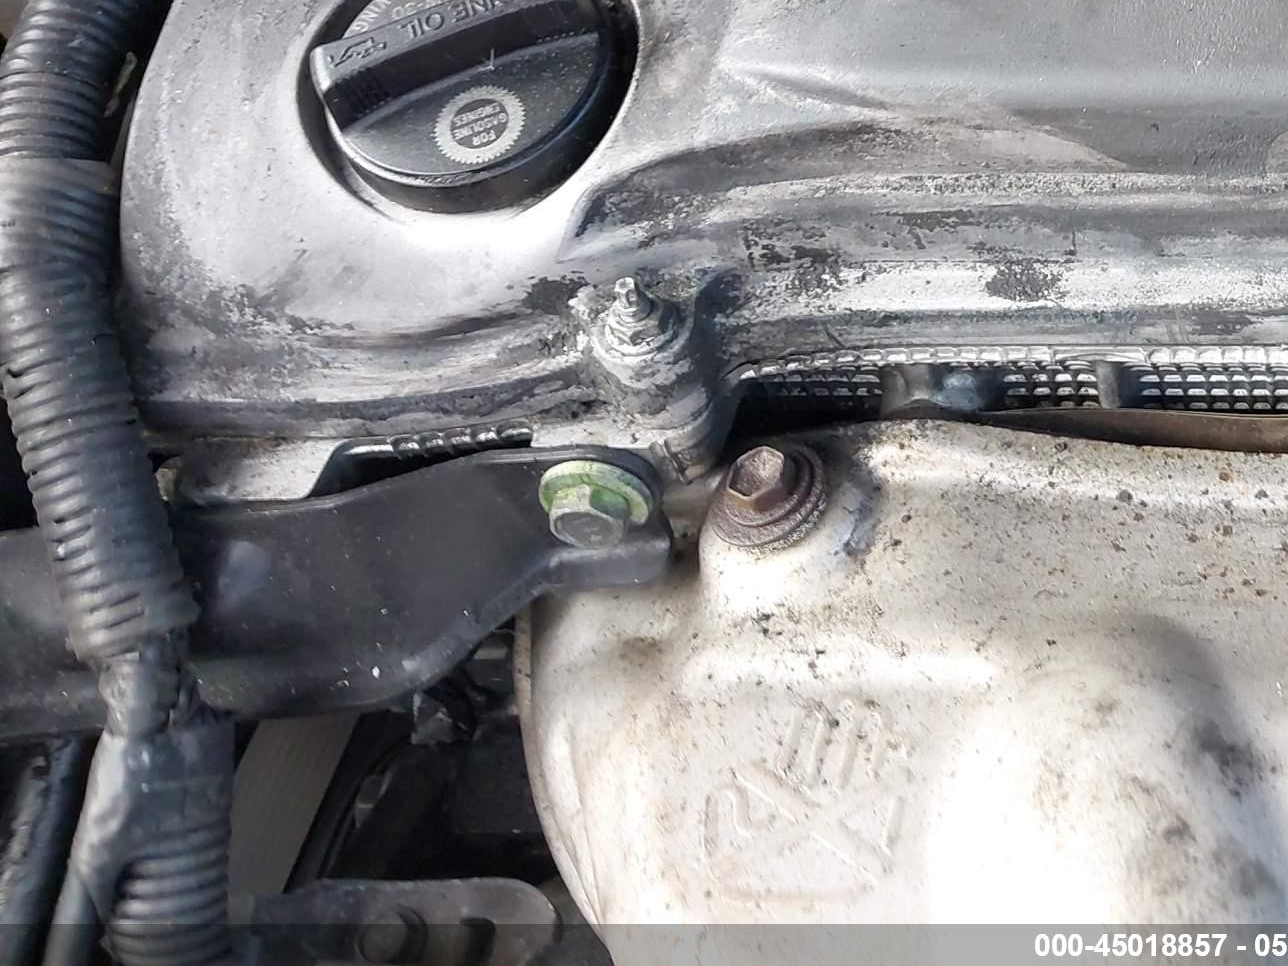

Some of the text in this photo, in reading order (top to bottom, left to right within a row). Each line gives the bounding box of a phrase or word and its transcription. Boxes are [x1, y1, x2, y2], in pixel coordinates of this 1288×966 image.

[400, 12, 446, 38] OIL
[453, 102, 500, 127] ENGINES
[453, 112, 508, 140] GASOLINE
[472, 129, 497, 146] FOR
